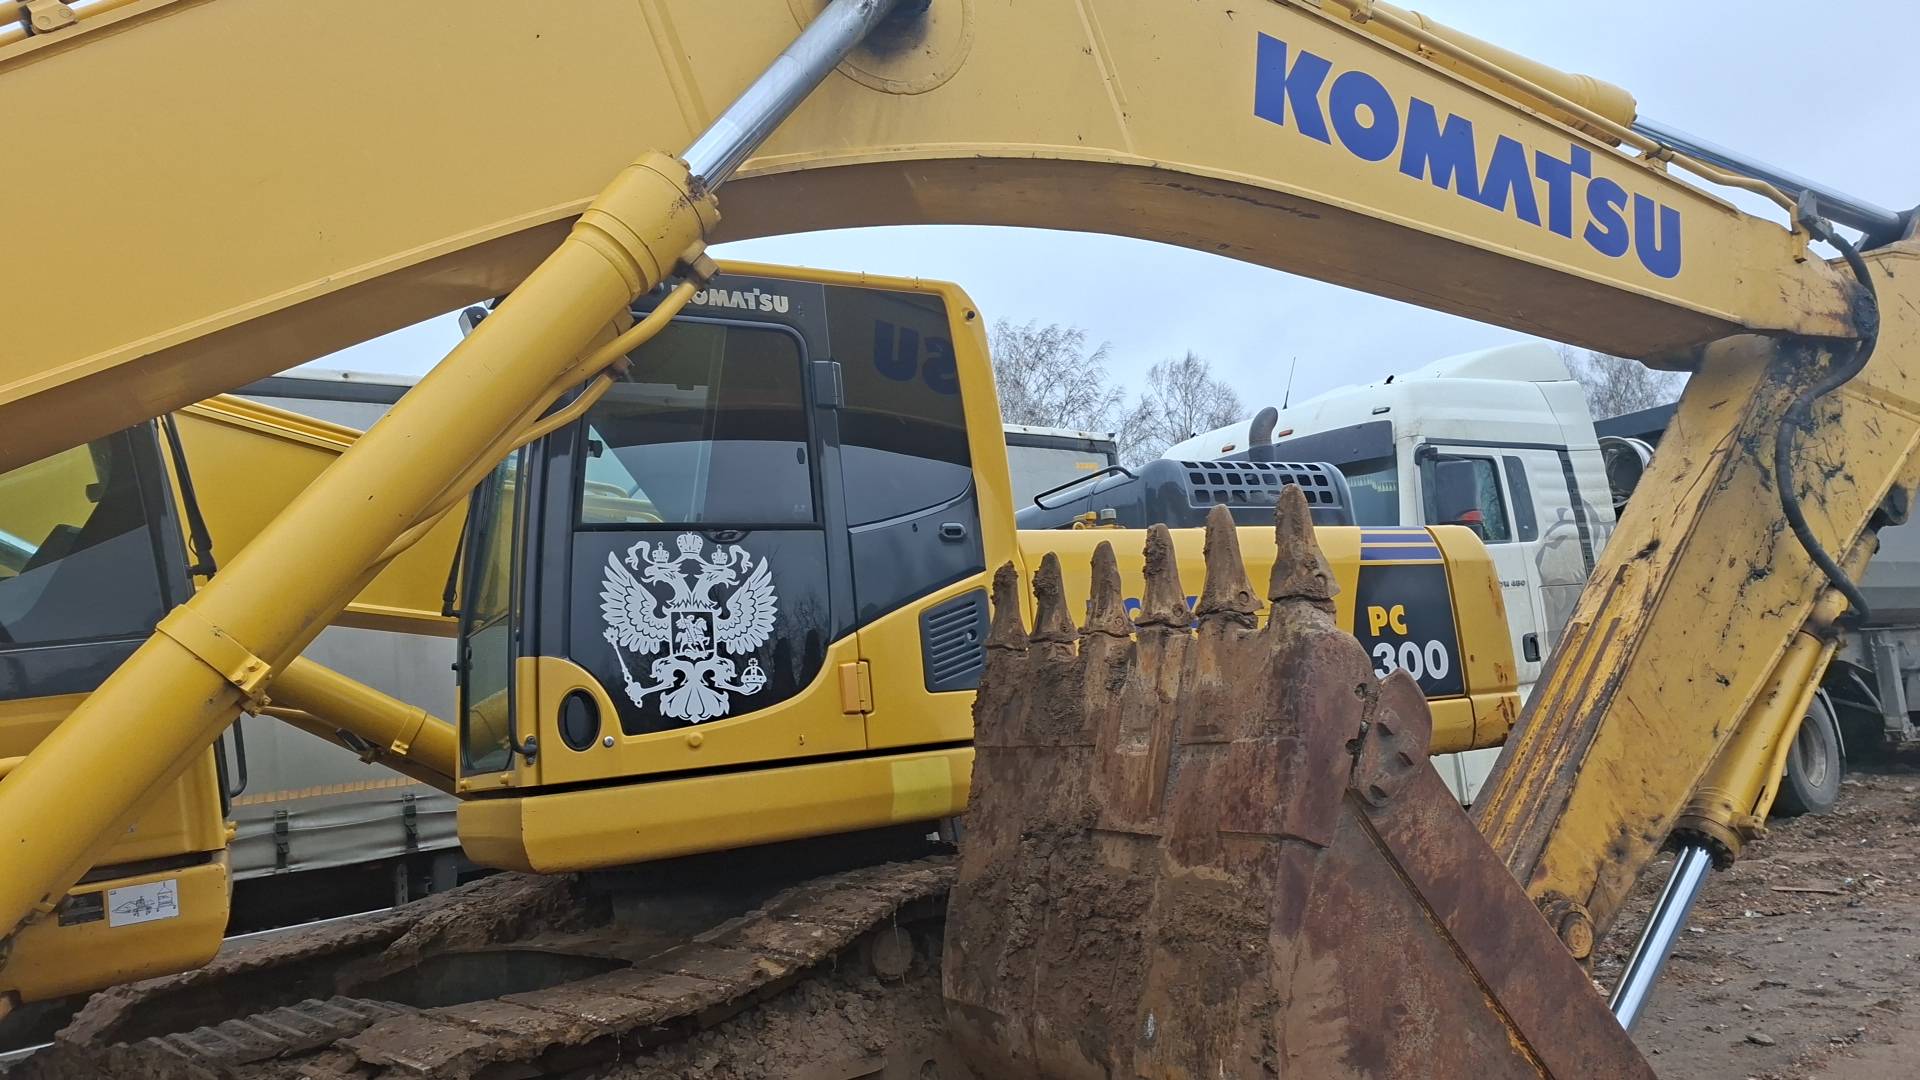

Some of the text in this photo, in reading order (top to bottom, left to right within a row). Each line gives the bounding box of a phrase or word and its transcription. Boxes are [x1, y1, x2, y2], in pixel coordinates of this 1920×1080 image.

[1254, 31, 1682, 279] KOMATSU
[671, 284, 789, 313] OMATSU
[1367, 604, 1408, 637] PC
[1372, 639, 1449, 681] 300
